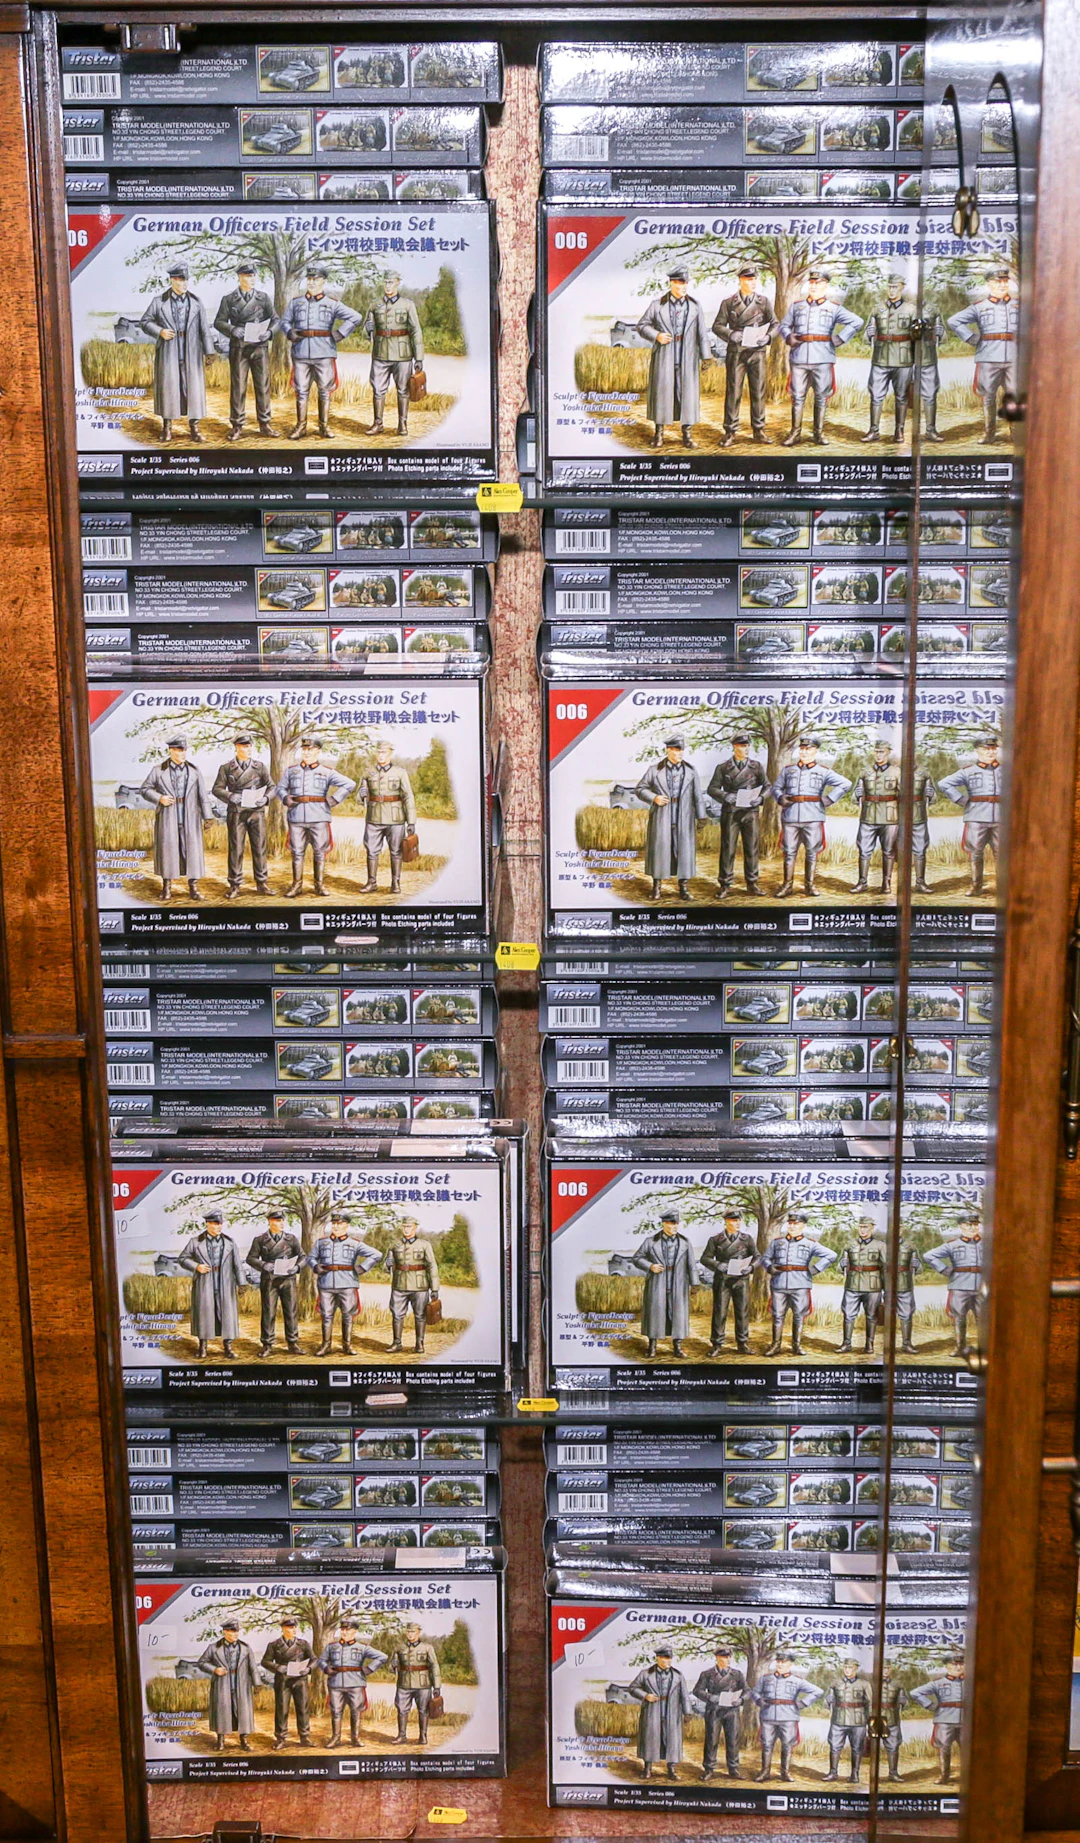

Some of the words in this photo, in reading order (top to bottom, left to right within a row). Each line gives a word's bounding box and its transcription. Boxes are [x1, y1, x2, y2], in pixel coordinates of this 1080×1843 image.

[65, 115, 100, 129] istar
[66, 178, 105, 192] ristar
[132, 216, 203, 232] German
[208, 216, 278, 236] Officers
[282, 216, 329, 232] Field
[334, 216, 402, 231] Session
[407, 216, 436, 231] Set
[634, 218, 705, 235] German
[712, 218, 782, 239] Officers
[787, 218, 834, 235] Field
[840, 218, 909, 235] Session
[68, 229, 88, 247] 06
[554, 231, 587, 249] 006
[553, 392, 577, 401] Sculpt
[129, 456, 147, 464] Scale
[659, 462, 678, 470] Series
[154, 467, 189, 475] Supervised
[189, 467, 197, 475] by
[619, 473, 642, 481] Project
[643, 473, 678, 481] Supervised
[679, 473, 687, 482] by
[719, 473, 745, 481] Nakada
[560, 572, 606, 584] Tristar
[132, 691, 200, 706] German
[206, 691, 274, 709] Officers
[277, 691, 323, 705] Field
[328, 691, 394, 705] Session
[399, 690, 427, 704] Set
[632, 691, 700, 706] German
[706, 690, 774, 709] Officers
[778, 690, 824, 705] Field
[829, 690, 894, 704] Session
[556, 703, 588, 720] 006
[154, 923, 188, 931] Supervised
[188, 923, 196, 931] by
[397, 920, 417, 928] Etching
[552, 988, 596, 1000] Tristar
[561, 1043, 604, 1055] Tristar
[561, 1096, 605, 1108] Tristar
[171, 1171, 236, 1185] German
[241, 1171, 305, 1188] Officers
[308, 1171, 352, 1184] Field
[356, 1171, 418, 1184] Session
[423, 1171, 449, 1184] Set
[630, 1171, 694, 1184] German
[700, 1171, 764, 1188] Officers
[768, 1171, 811, 1184] Field
[816, 1171, 878, 1185] Session
[112, 1182, 130, 1197] 06
[558, 1181, 588, 1196] 006
[191, 1585, 251, 1597] German
[256, 1584, 316, 1599] Officers
[319, 1583, 359, 1595] Field
[364, 1582, 422, 1594] Session
[426, 1582, 451, 1593] Set
[136, 1595, 153, 1608] 06
[558, 1617, 587, 1631] 006
[626, 1609, 687, 1624] German
[692, 1611, 753, 1628] Officers
[757, 1614, 797, 1627] Field
[802, 1615, 861, 1629] Session
[562, 1789, 603, 1801] Tristar
